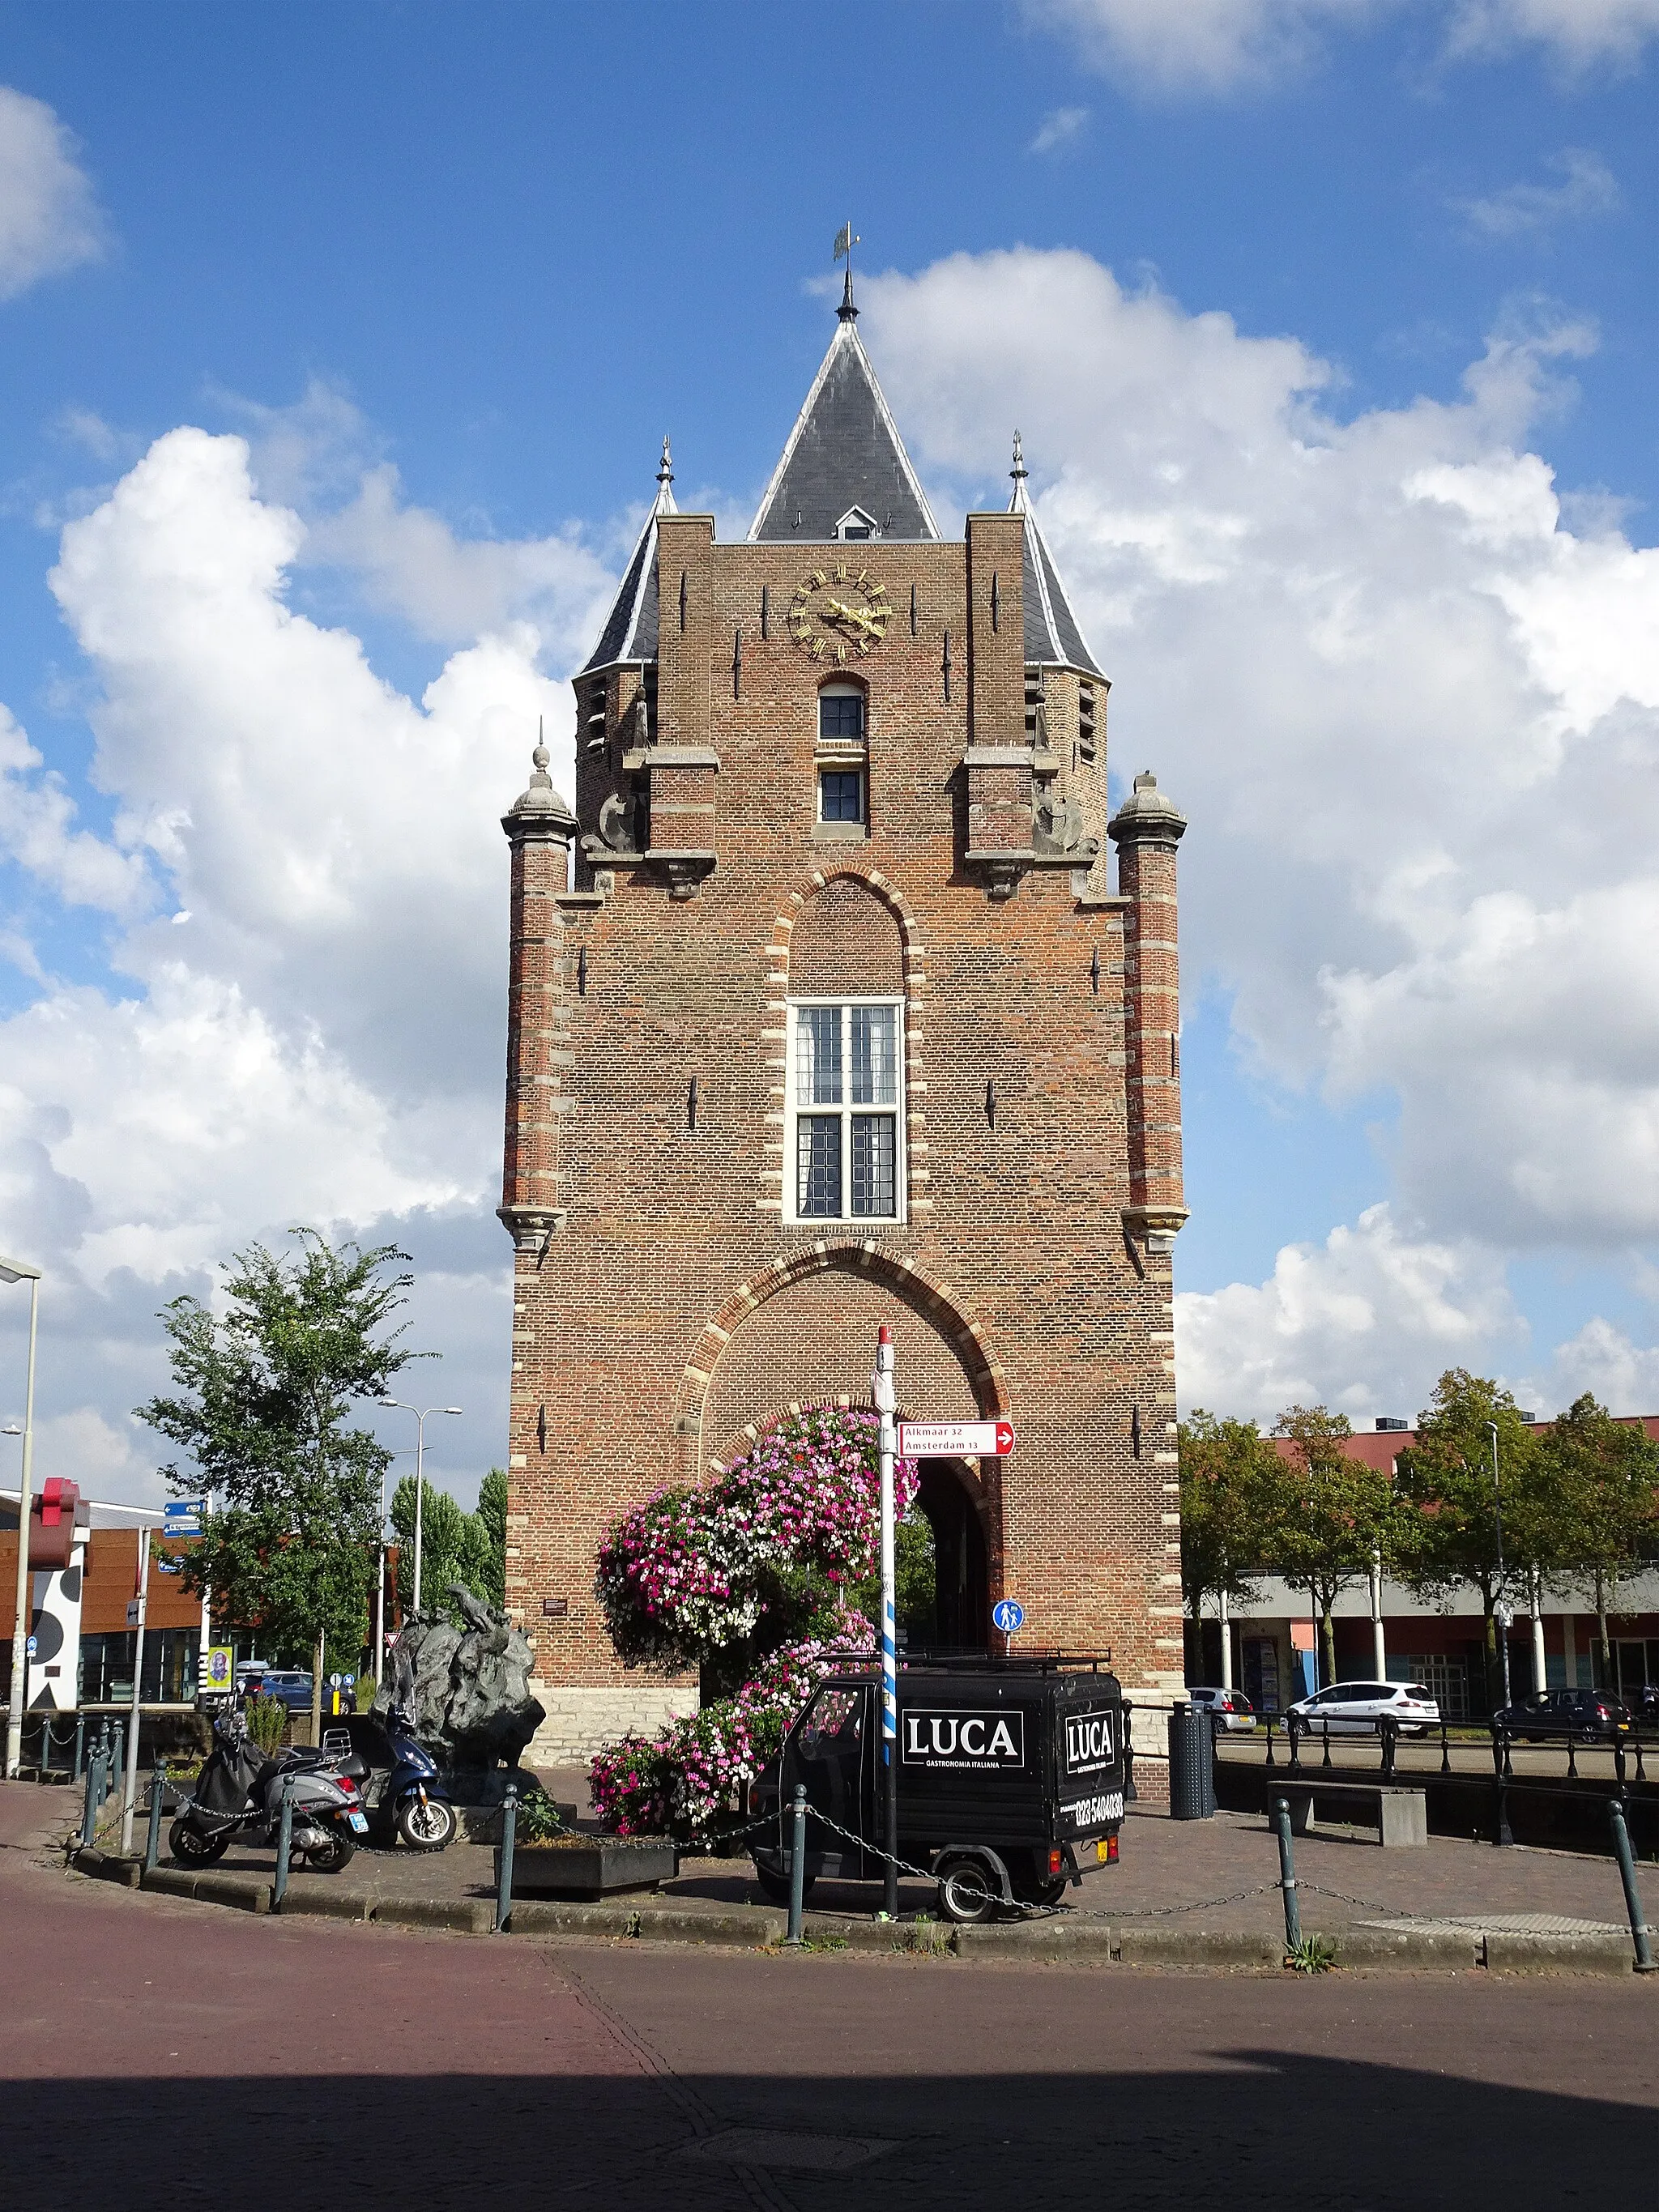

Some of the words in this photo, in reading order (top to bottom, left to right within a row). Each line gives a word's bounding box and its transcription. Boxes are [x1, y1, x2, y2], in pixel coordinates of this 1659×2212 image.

[905, 1428, 948, 1436] Alkmaar
[952, 1428, 962, 1436] 32
[905, 1442, 965, 1450] Amsterdam
[907, 1718, 1018, 1756] LUCA
[1068, 1720, 1112, 1762] LUCA
[926, 1759, 970, 1768] GASTRONOMIA
[971, 1761, 1000, 1769] ITALIANA
